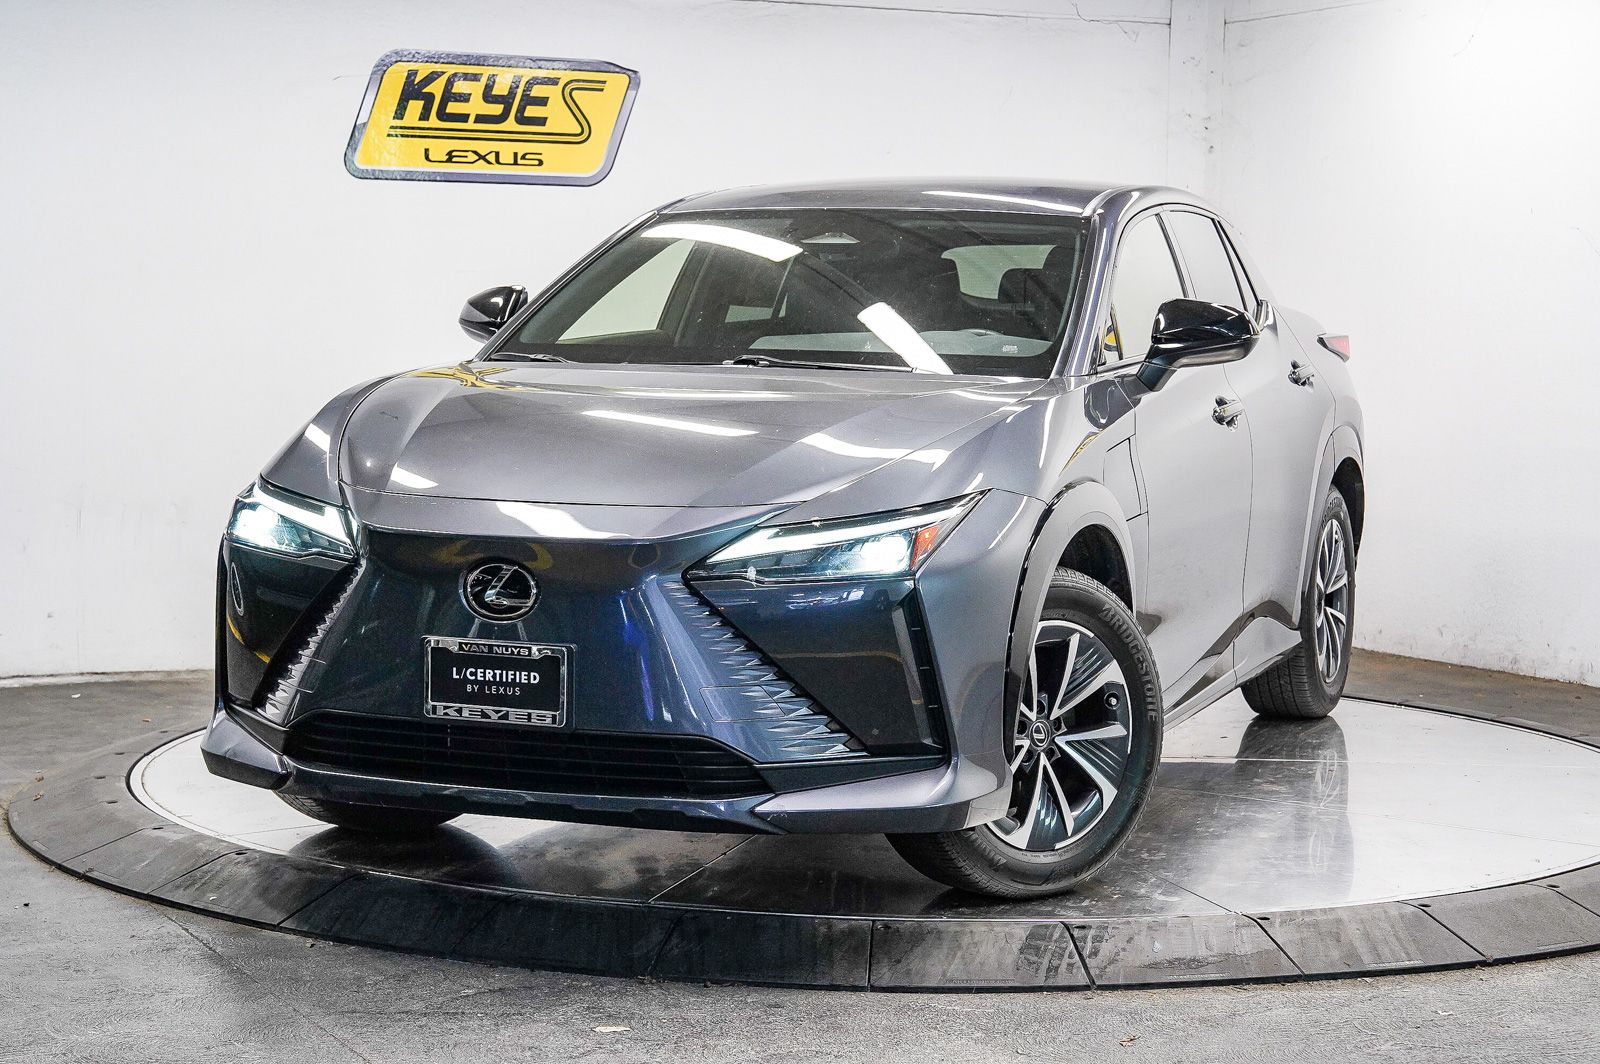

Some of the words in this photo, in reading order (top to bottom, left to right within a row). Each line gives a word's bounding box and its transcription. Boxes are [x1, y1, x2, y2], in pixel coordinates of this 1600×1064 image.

[391, 69, 607, 143] KEYES
[424, 148, 544, 166] LEXUS
[461, 643, 488, 653] VAN
[493, 646, 529, 656] NUYS
[1101, 603, 1158, 722] BRIDGESTONE
[466, 684, 479, 693] BY
[485, 686, 521, 696] LEXUS
[436, 705, 553, 724] KEYES
